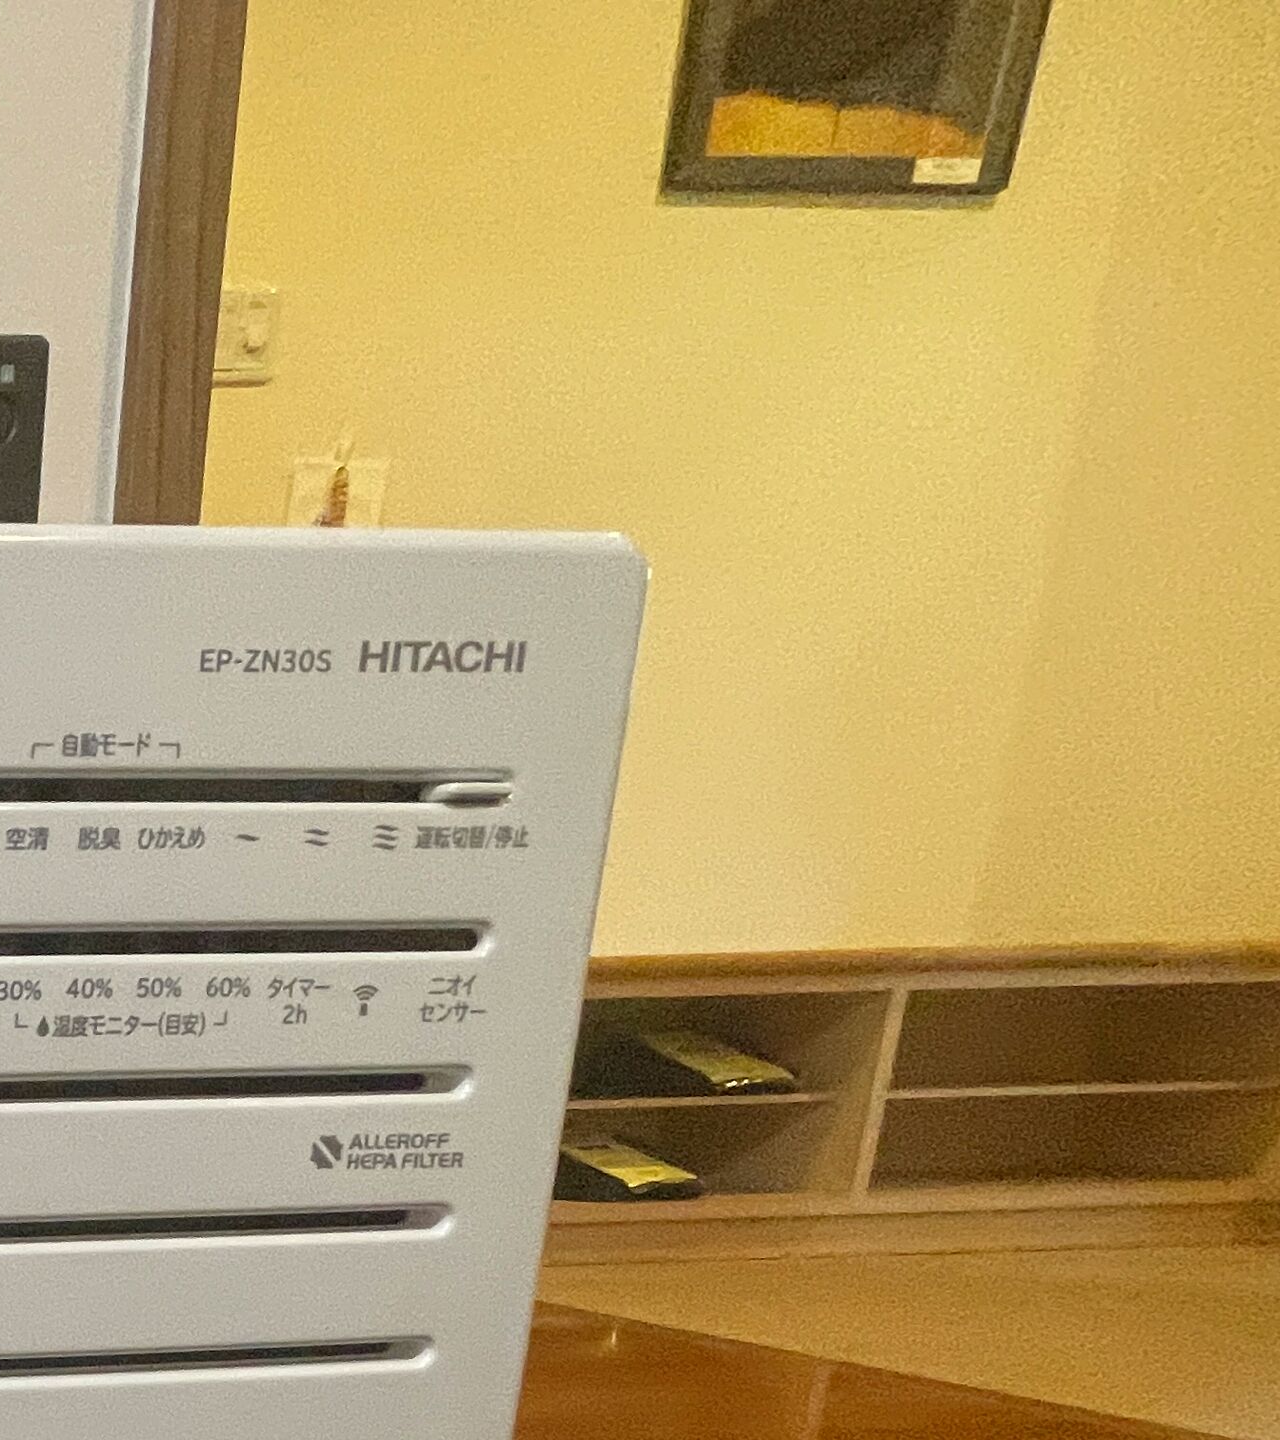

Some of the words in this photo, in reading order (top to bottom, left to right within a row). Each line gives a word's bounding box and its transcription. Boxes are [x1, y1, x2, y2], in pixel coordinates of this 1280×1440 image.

[199, 648, 332, 674] EP-ZN30S
[358, 640, 527, 674] HITACHI
[61, 732, 152, 758] 自動モード
[5, 826, 50, 852] 空清
[77, 826, 121, 851] 脱臭
[137, 825, 206, 851] ひかえめ
[65, 977, 114, 1000] 40%
[135, 976, 183, 999] 50%
[205, 976, 252, 999] 60%
[267, 977, 332, 1000] タイマー
[428, 974, 478, 997] ニオイ
[281, 1003, 308, 1026] 2h
[419, 1001, 487, 1024] センサー
[348, 1132, 451, 1151] ALLEROFF
[346, 1152, 398, 1170] HEPA
[400, 1151, 464, 1170] FILTER
